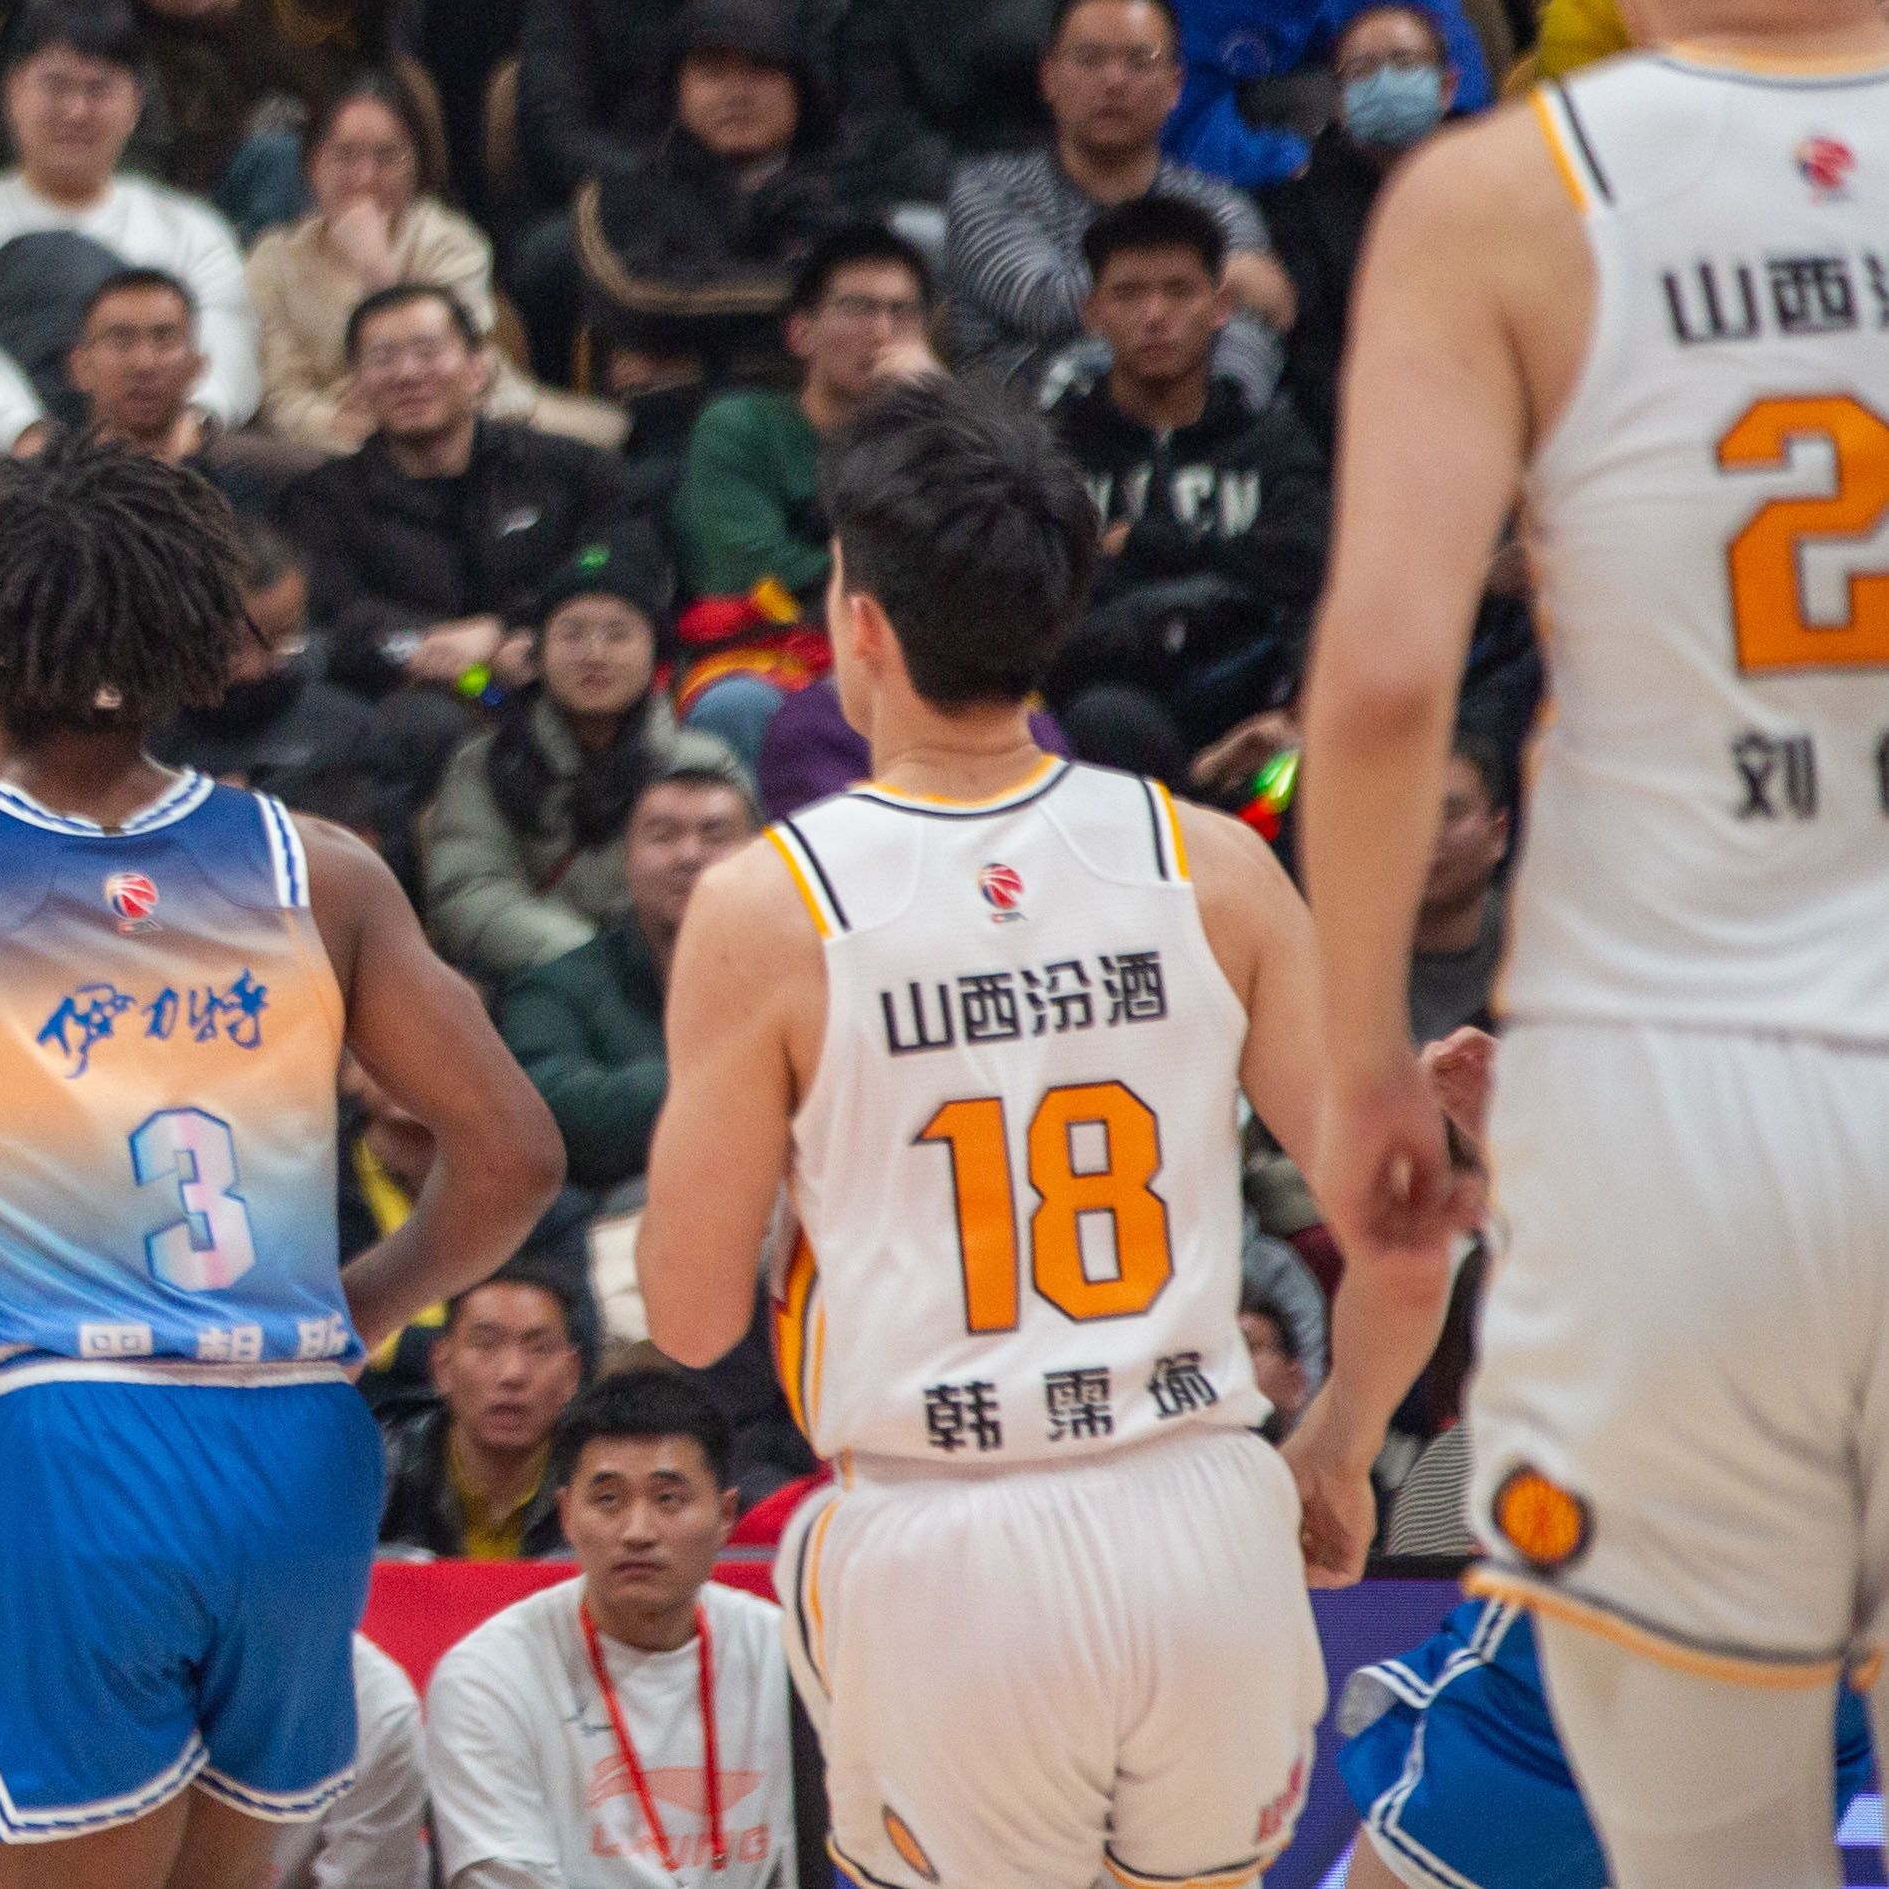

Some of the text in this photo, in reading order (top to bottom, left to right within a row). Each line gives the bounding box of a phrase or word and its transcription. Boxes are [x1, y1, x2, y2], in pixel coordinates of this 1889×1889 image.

[1662, 252, 1889, 346] 山西
[881, 949, 1170, 1057] 山西汾酒
[128, 1106, 257, 1292] 3
[909, 1078, 1177, 1337] 18
